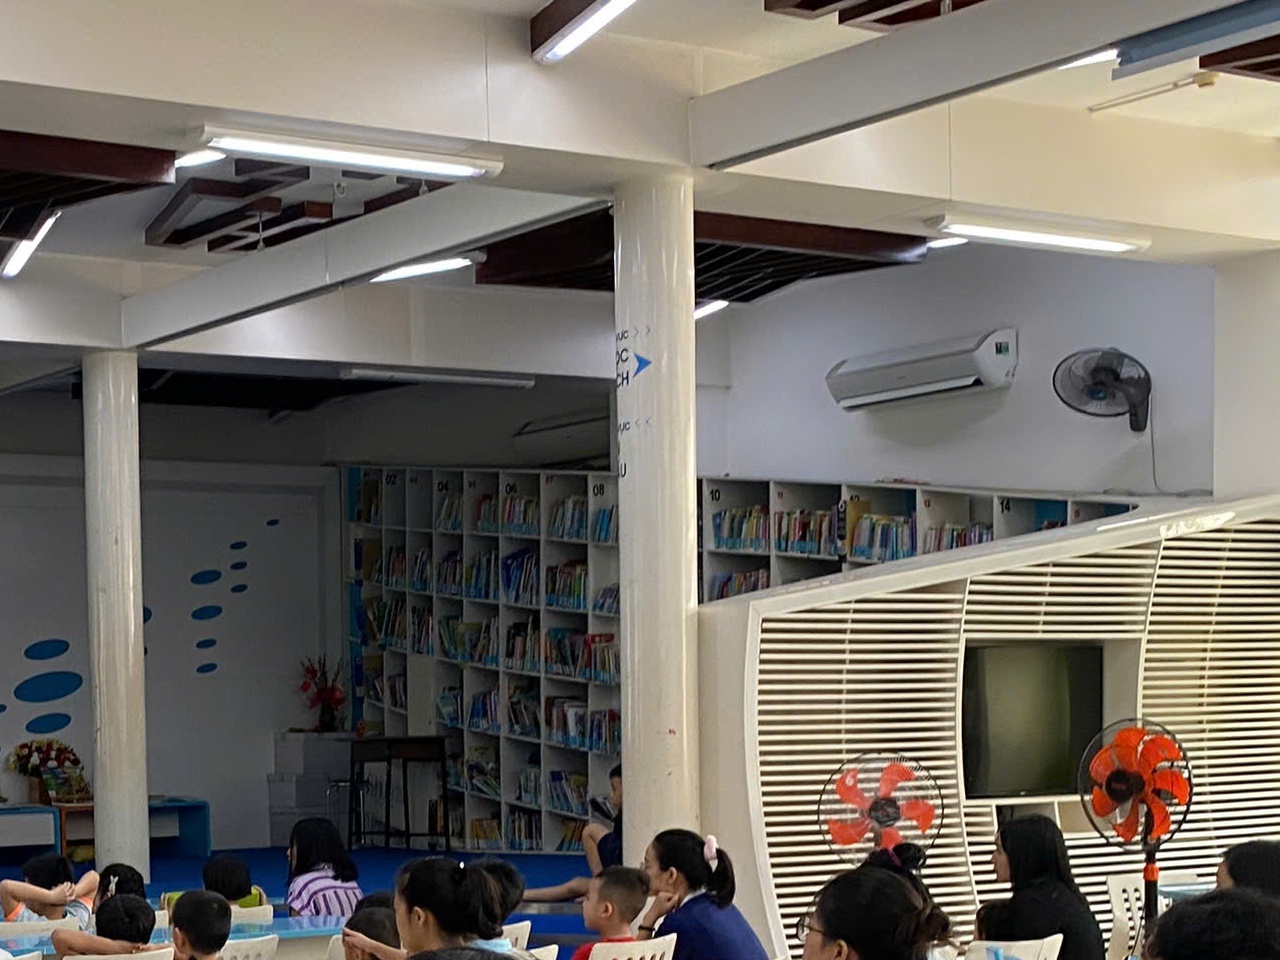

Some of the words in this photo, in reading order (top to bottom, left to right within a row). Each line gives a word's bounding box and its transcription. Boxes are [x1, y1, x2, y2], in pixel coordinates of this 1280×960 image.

[592, 483, 605, 496] 08
[710, 488, 721, 502] 10
[1000, 498, 1011, 514] 14
